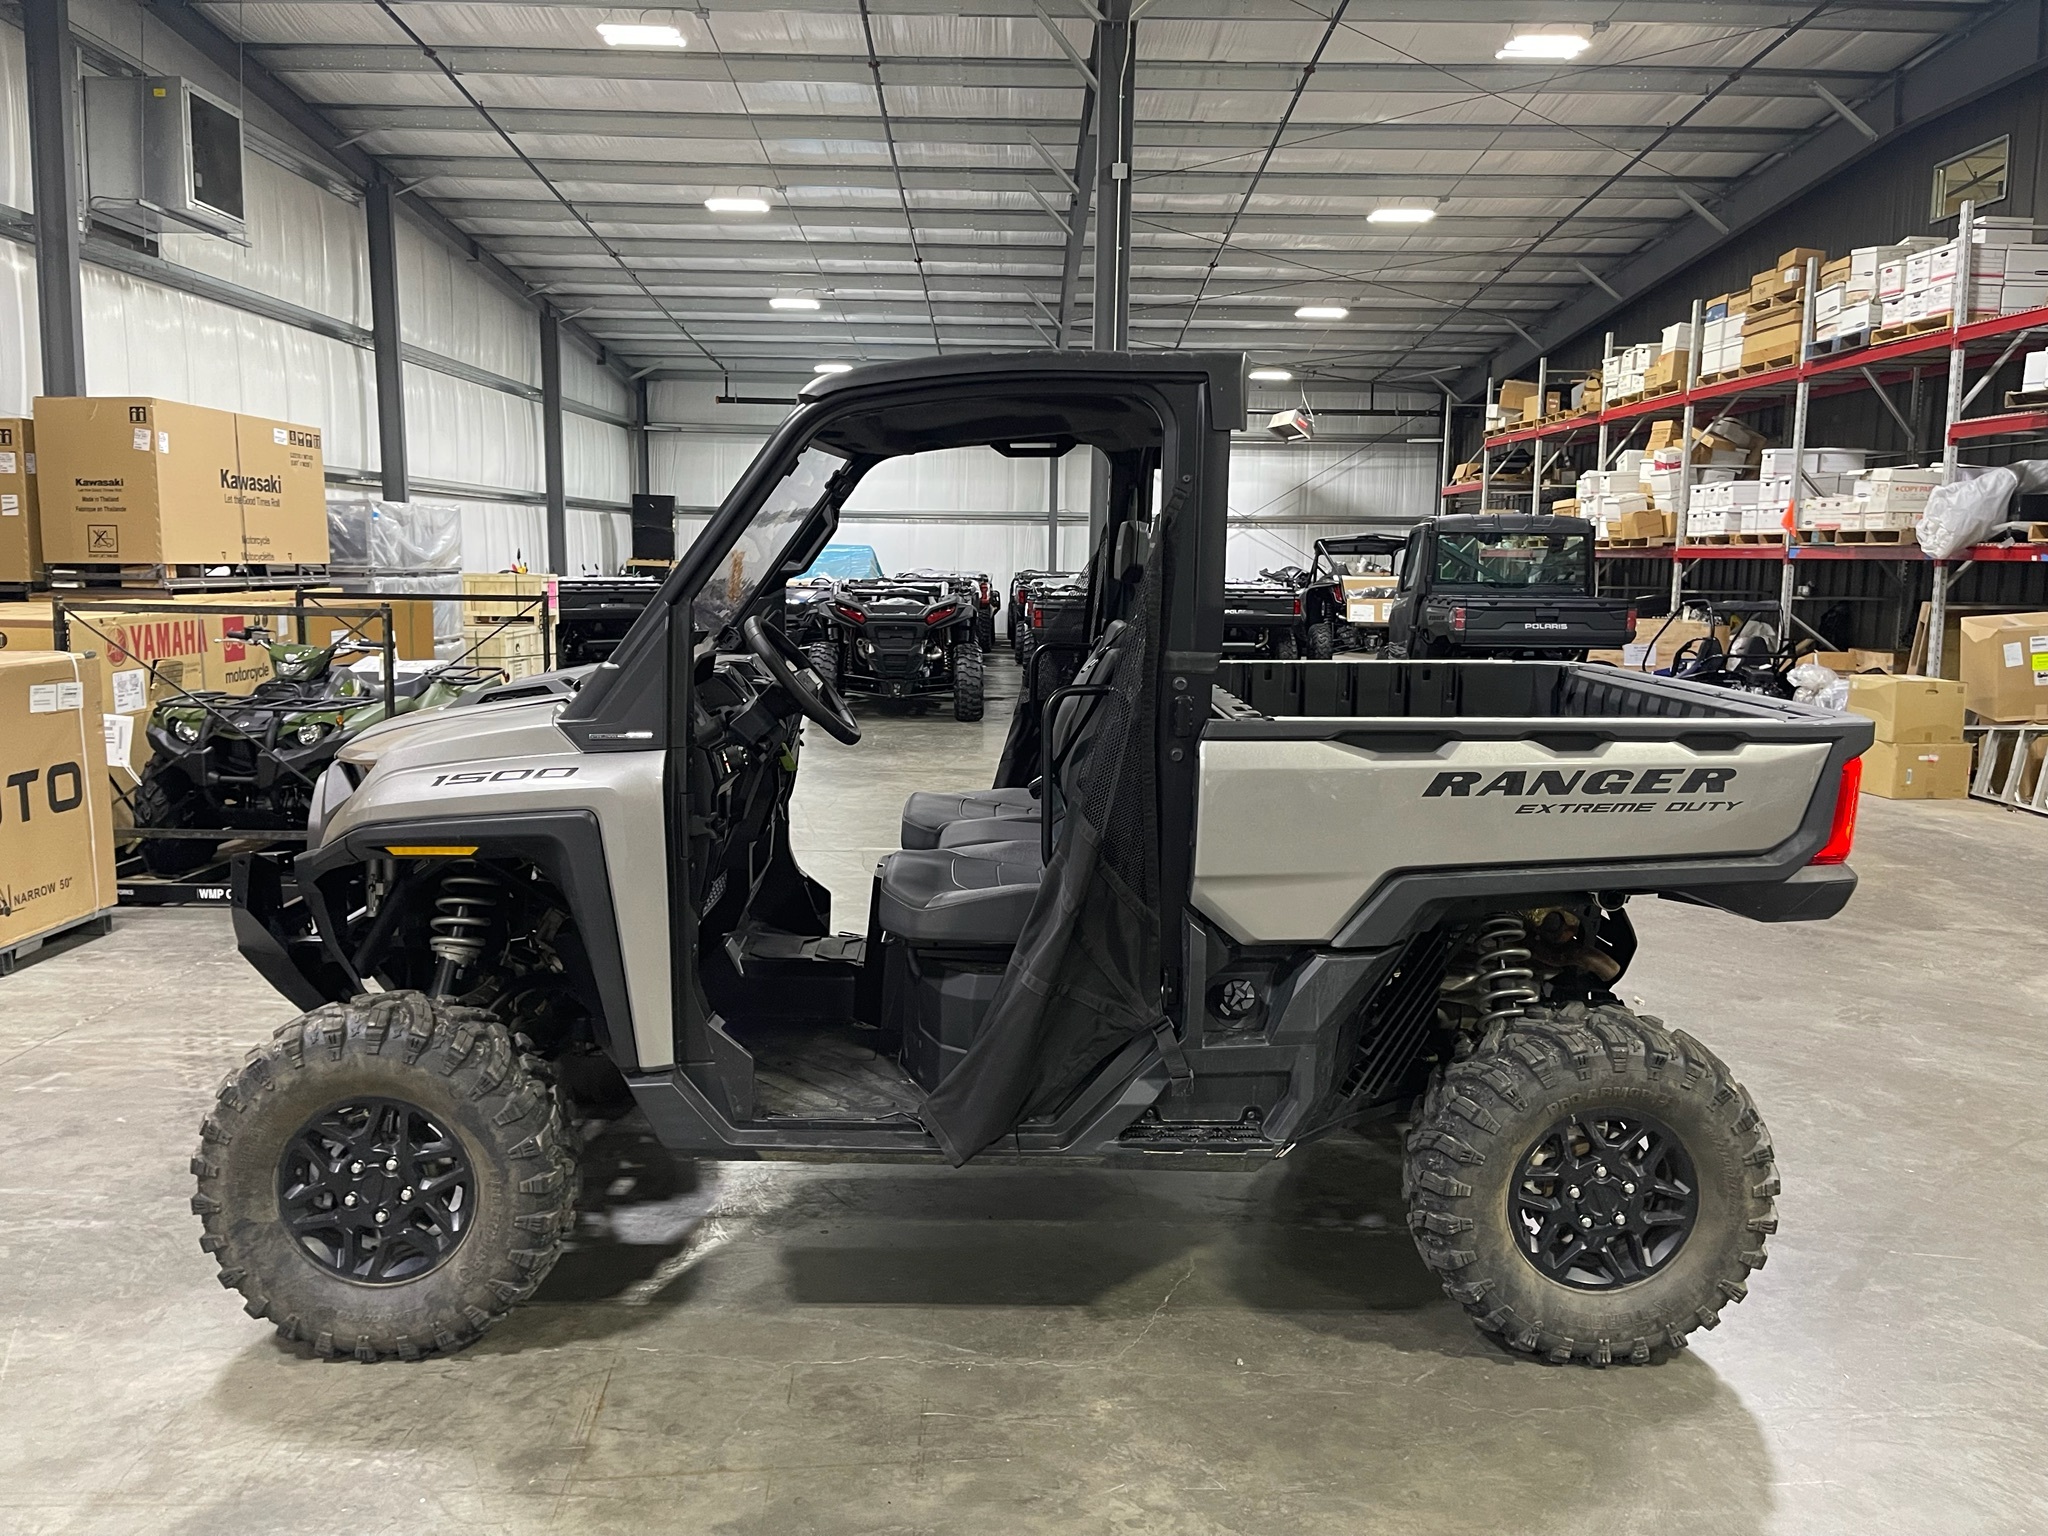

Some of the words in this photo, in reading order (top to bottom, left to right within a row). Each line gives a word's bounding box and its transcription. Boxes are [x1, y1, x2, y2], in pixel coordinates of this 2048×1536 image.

[75, 478, 123, 486] Kawasaki
[220, 468, 282, 494] Kawasaki
[130, 619, 208, 660] YAMAHA
[225, 663, 270, 684] motorcycle
[431, 767, 579, 787] 1500
[1421, 768, 1737, 797] RANGER
[0, 761, 83, 824] TO
[1514, 803, 1656, 814] EXTREME
[1665, 801, 1744, 812] DUTY
[14, 882, 56, 906] NARROW
[198, 888, 224, 900] WMP
